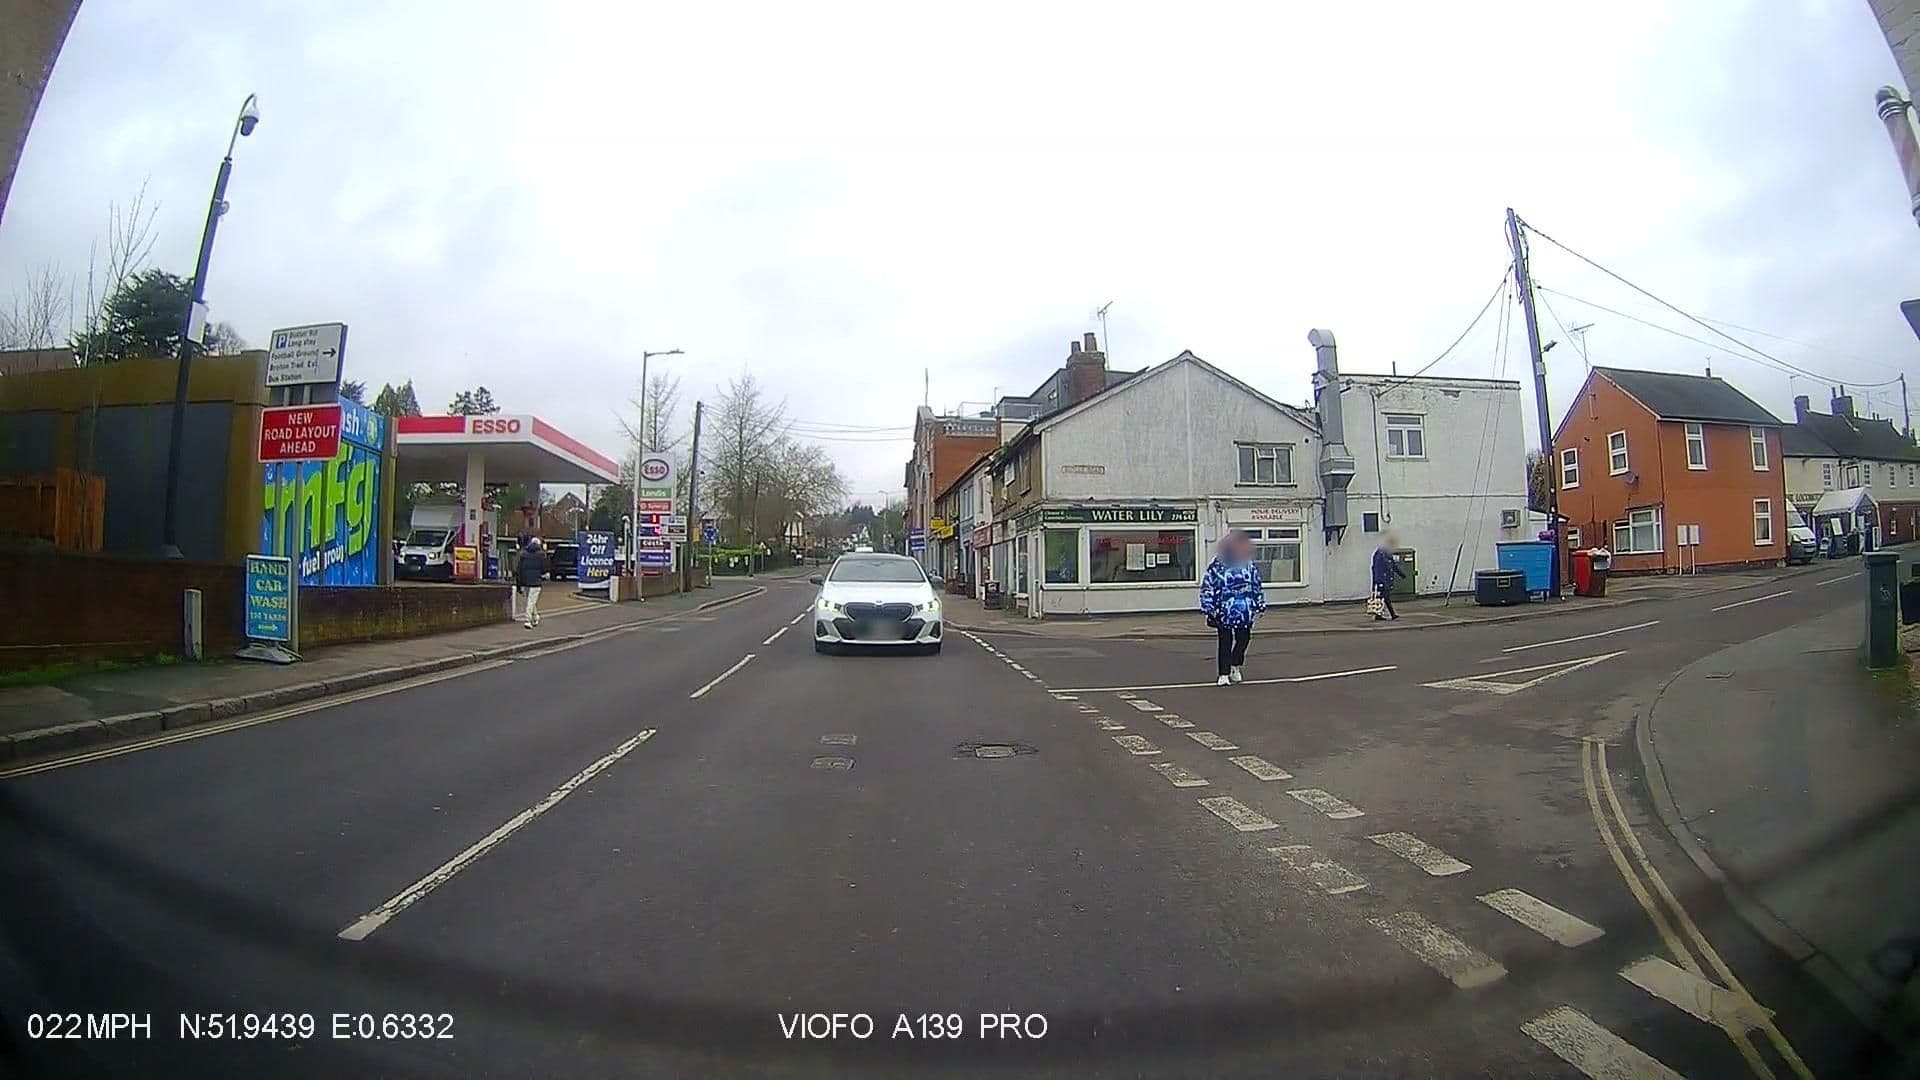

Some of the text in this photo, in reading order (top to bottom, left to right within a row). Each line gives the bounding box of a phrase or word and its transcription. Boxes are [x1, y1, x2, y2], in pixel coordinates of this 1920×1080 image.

[288, 340, 302, 348] Long
[271, 348, 319, 360] Football Ground
[268, 375, 279, 383] Bus
[288, 412, 313, 425] NEW
[264, 425, 336, 440] ROAD LAYOUT
[472, 419, 521, 434] ESSO
[279, 441, 316, 454] AHEAD
[641, 489, 667, 497] Londis
[1092, 509, 1134, 521] WATER
[1139, 510, 1165, 521] LILY
[586, 534, 609, 545] 24hr
[589, 545, 606, 554] Off
[250, 560, 287, 575] HAND
[302, 551, 320, 577] fuel
[580, 556, 615, 567] Licence
[586, 567, 609, 577] Here
[256, 579, 283, 592] CAR
[250, 595, 288, 608] WASH
